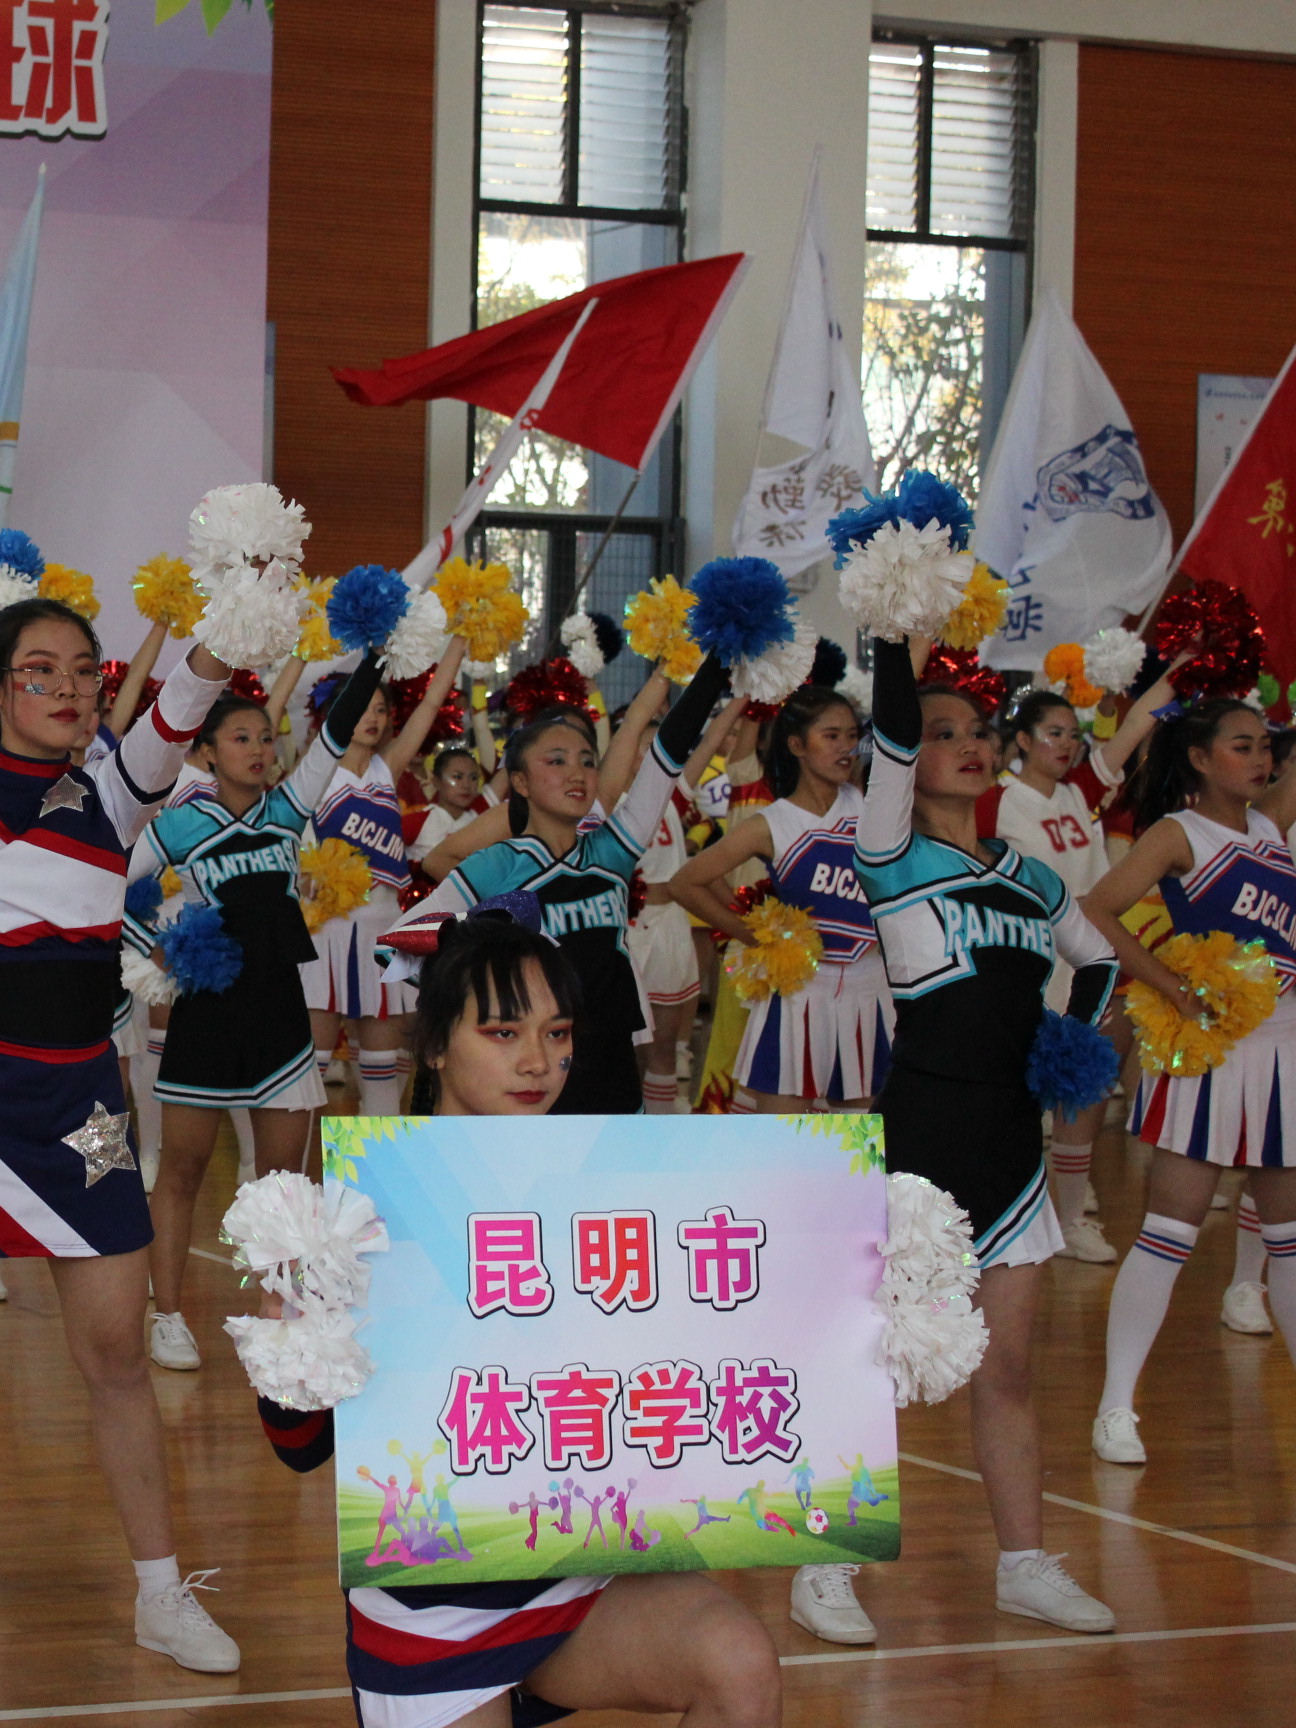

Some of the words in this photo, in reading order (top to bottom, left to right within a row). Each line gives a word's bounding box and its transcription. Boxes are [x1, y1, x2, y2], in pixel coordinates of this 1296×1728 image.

[466, 1208, 764, 1316] 昆明市
[440, 1361, 799, 1472] 体育学校
